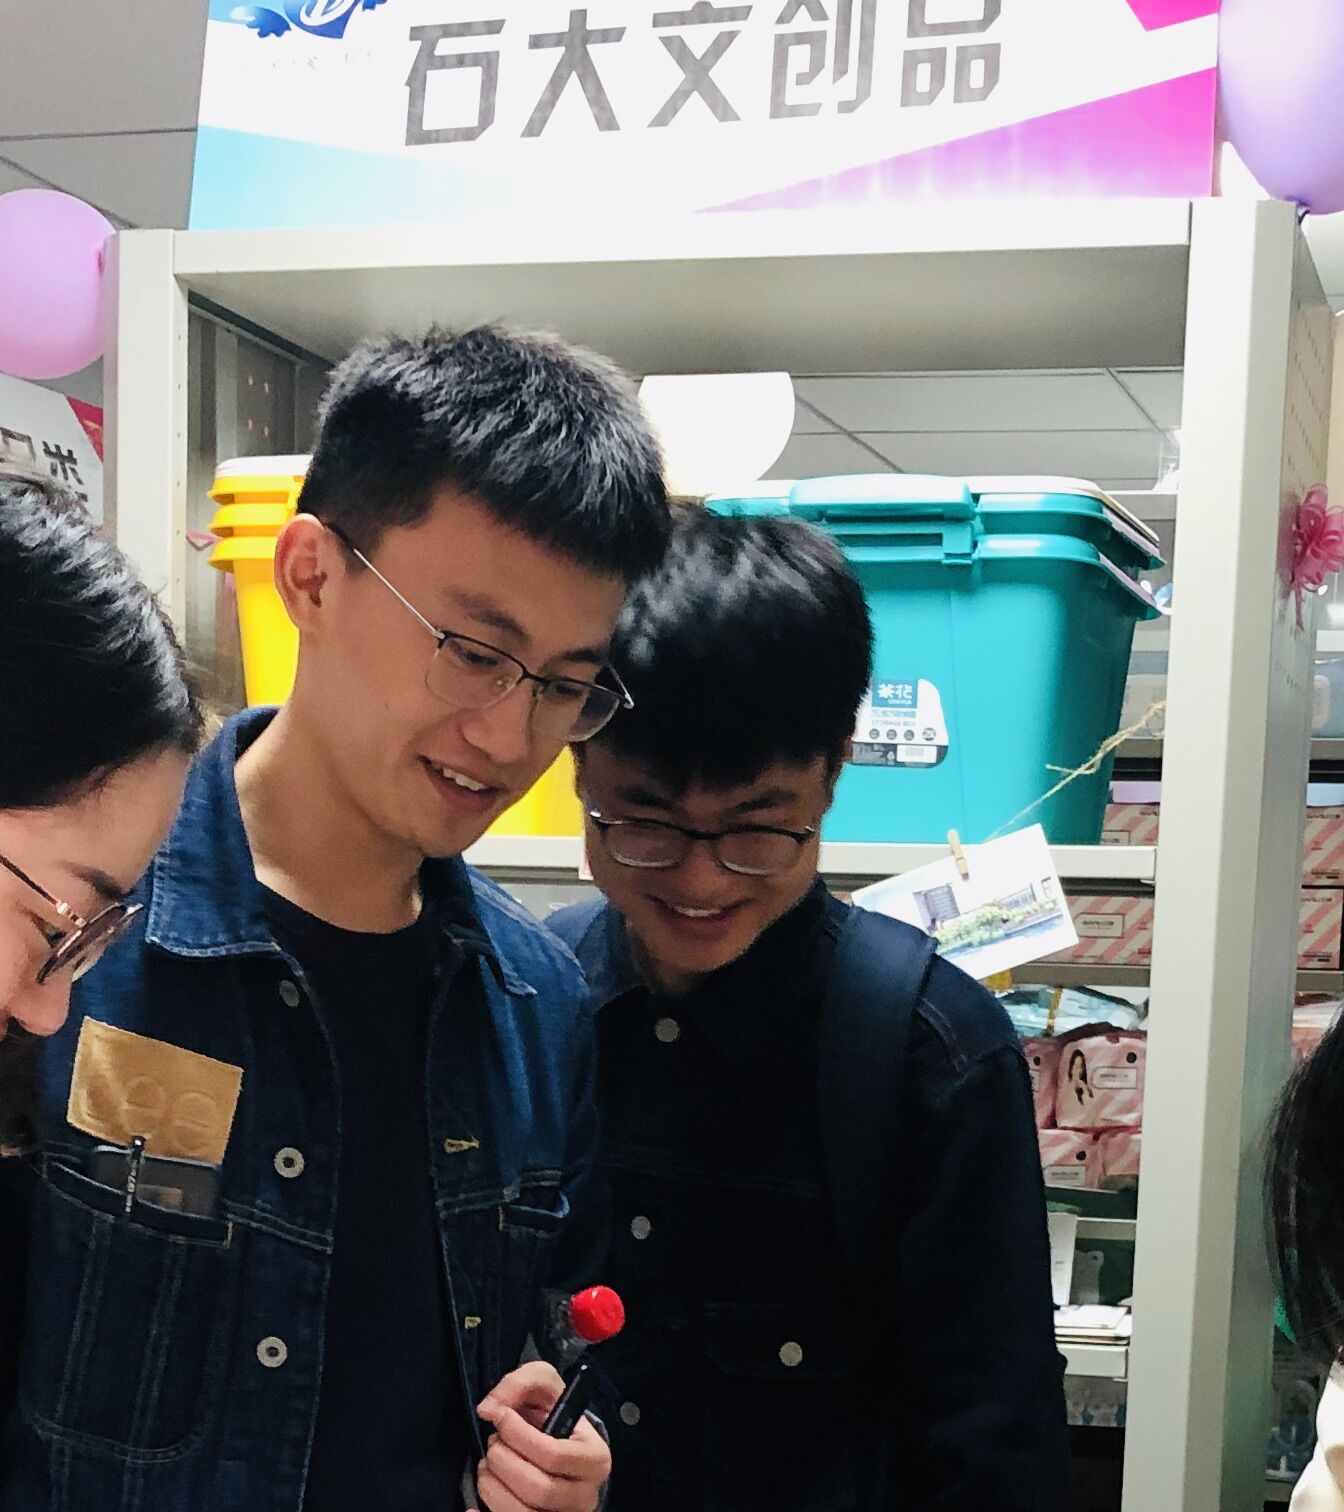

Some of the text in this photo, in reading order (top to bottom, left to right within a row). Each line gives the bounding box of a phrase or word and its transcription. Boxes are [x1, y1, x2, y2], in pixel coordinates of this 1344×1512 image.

[402, 0, 1004, 148] 石大文创品
[878, 683, 912, 699] 茶花
